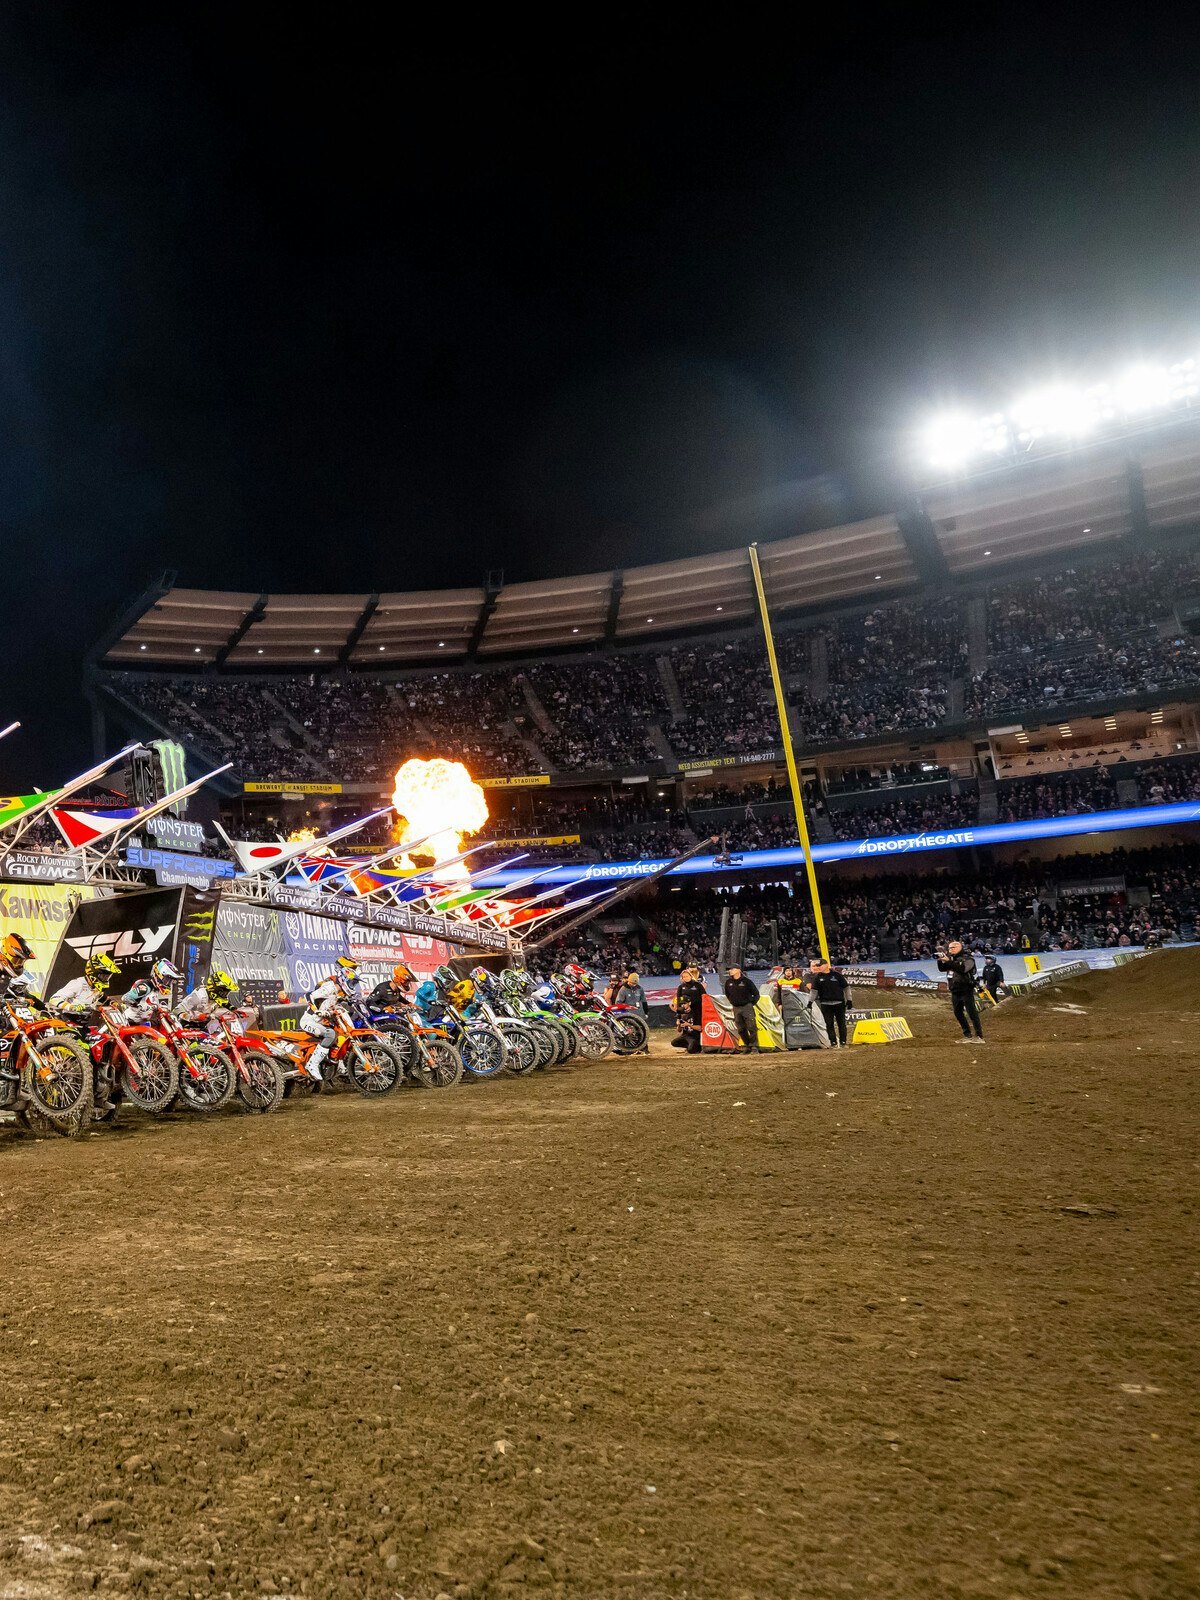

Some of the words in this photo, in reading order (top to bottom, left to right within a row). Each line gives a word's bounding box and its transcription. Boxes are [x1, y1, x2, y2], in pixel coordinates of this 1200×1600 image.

[128, 838, 142, 848] AMA
[158, 838, 198, 848] ENERGY
[858, 832, 974, 853] #DROPTHEGATE
[16, 853, 40, 864] ROCKY
[40, 855, 76, 867] MOUNTAIN
[126, 847, 235, 878] SUPERCROSS
[161, 871, 209, 888] Championship
[299, 912, 343, 941] YAMAHA
[64, 925, 175, 960] FLY
[295, 942, 344, 951] RACING
